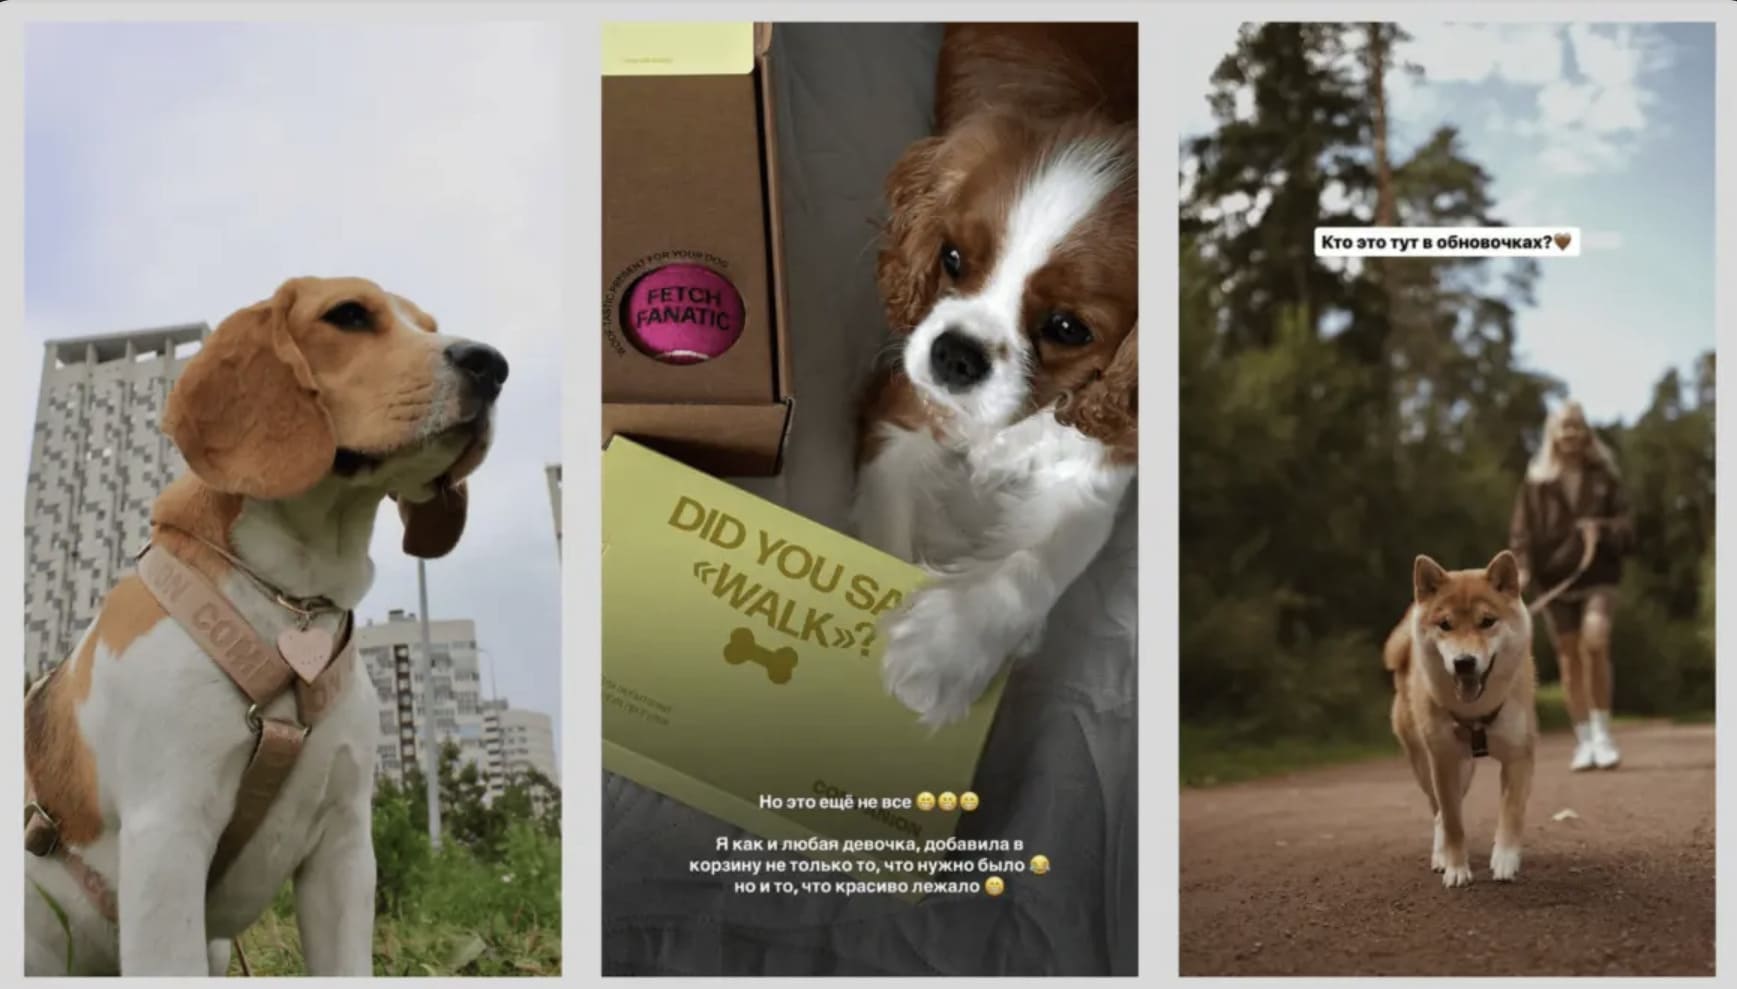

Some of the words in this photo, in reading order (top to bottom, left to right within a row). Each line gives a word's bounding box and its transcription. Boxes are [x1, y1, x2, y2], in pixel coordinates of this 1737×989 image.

[636, 305, 731, 331] FANATIC
[647, 285, 721, 307] FETCH
[667, 495, 747, 550] DID
[756, 529, 845, 594] YOU
[844, 573, 904, 616] SA
[693, 559, 878, 658] «WALK»?
